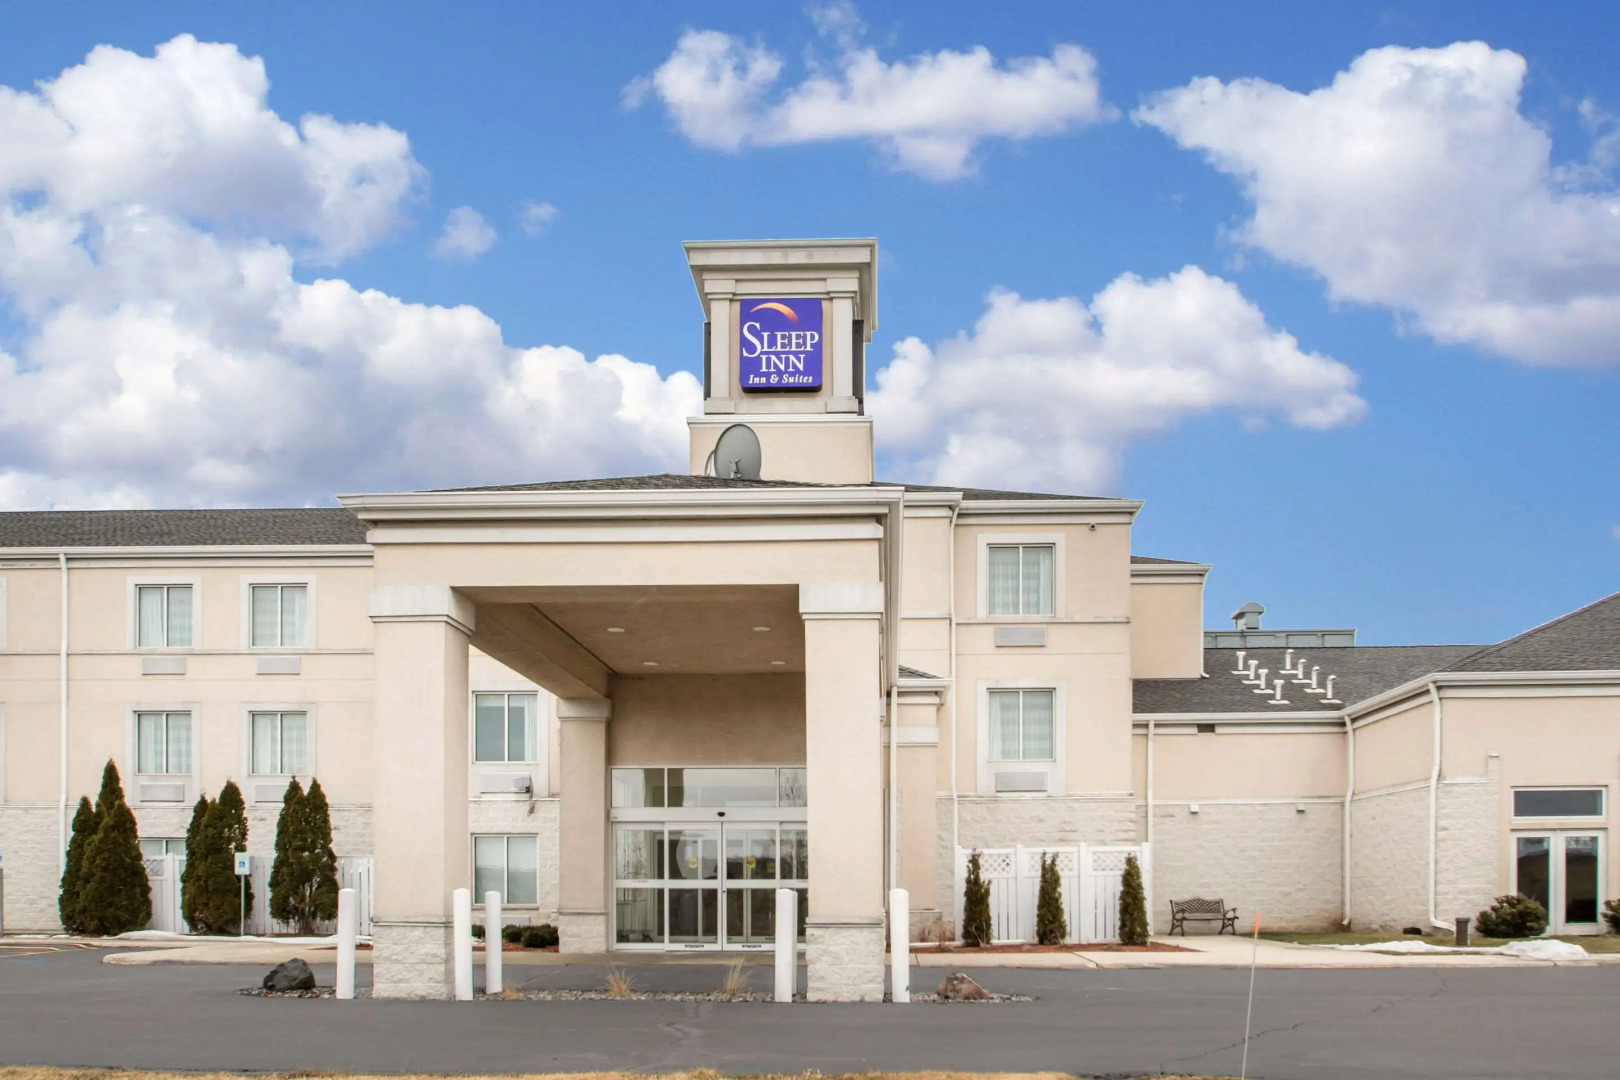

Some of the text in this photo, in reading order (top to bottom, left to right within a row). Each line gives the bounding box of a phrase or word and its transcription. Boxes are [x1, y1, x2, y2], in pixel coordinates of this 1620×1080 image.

[742, 321, 819, 358] SLEEP
[760, 354, 806, 372] INN
[748, 373, 813, 384] Inn & Suites
